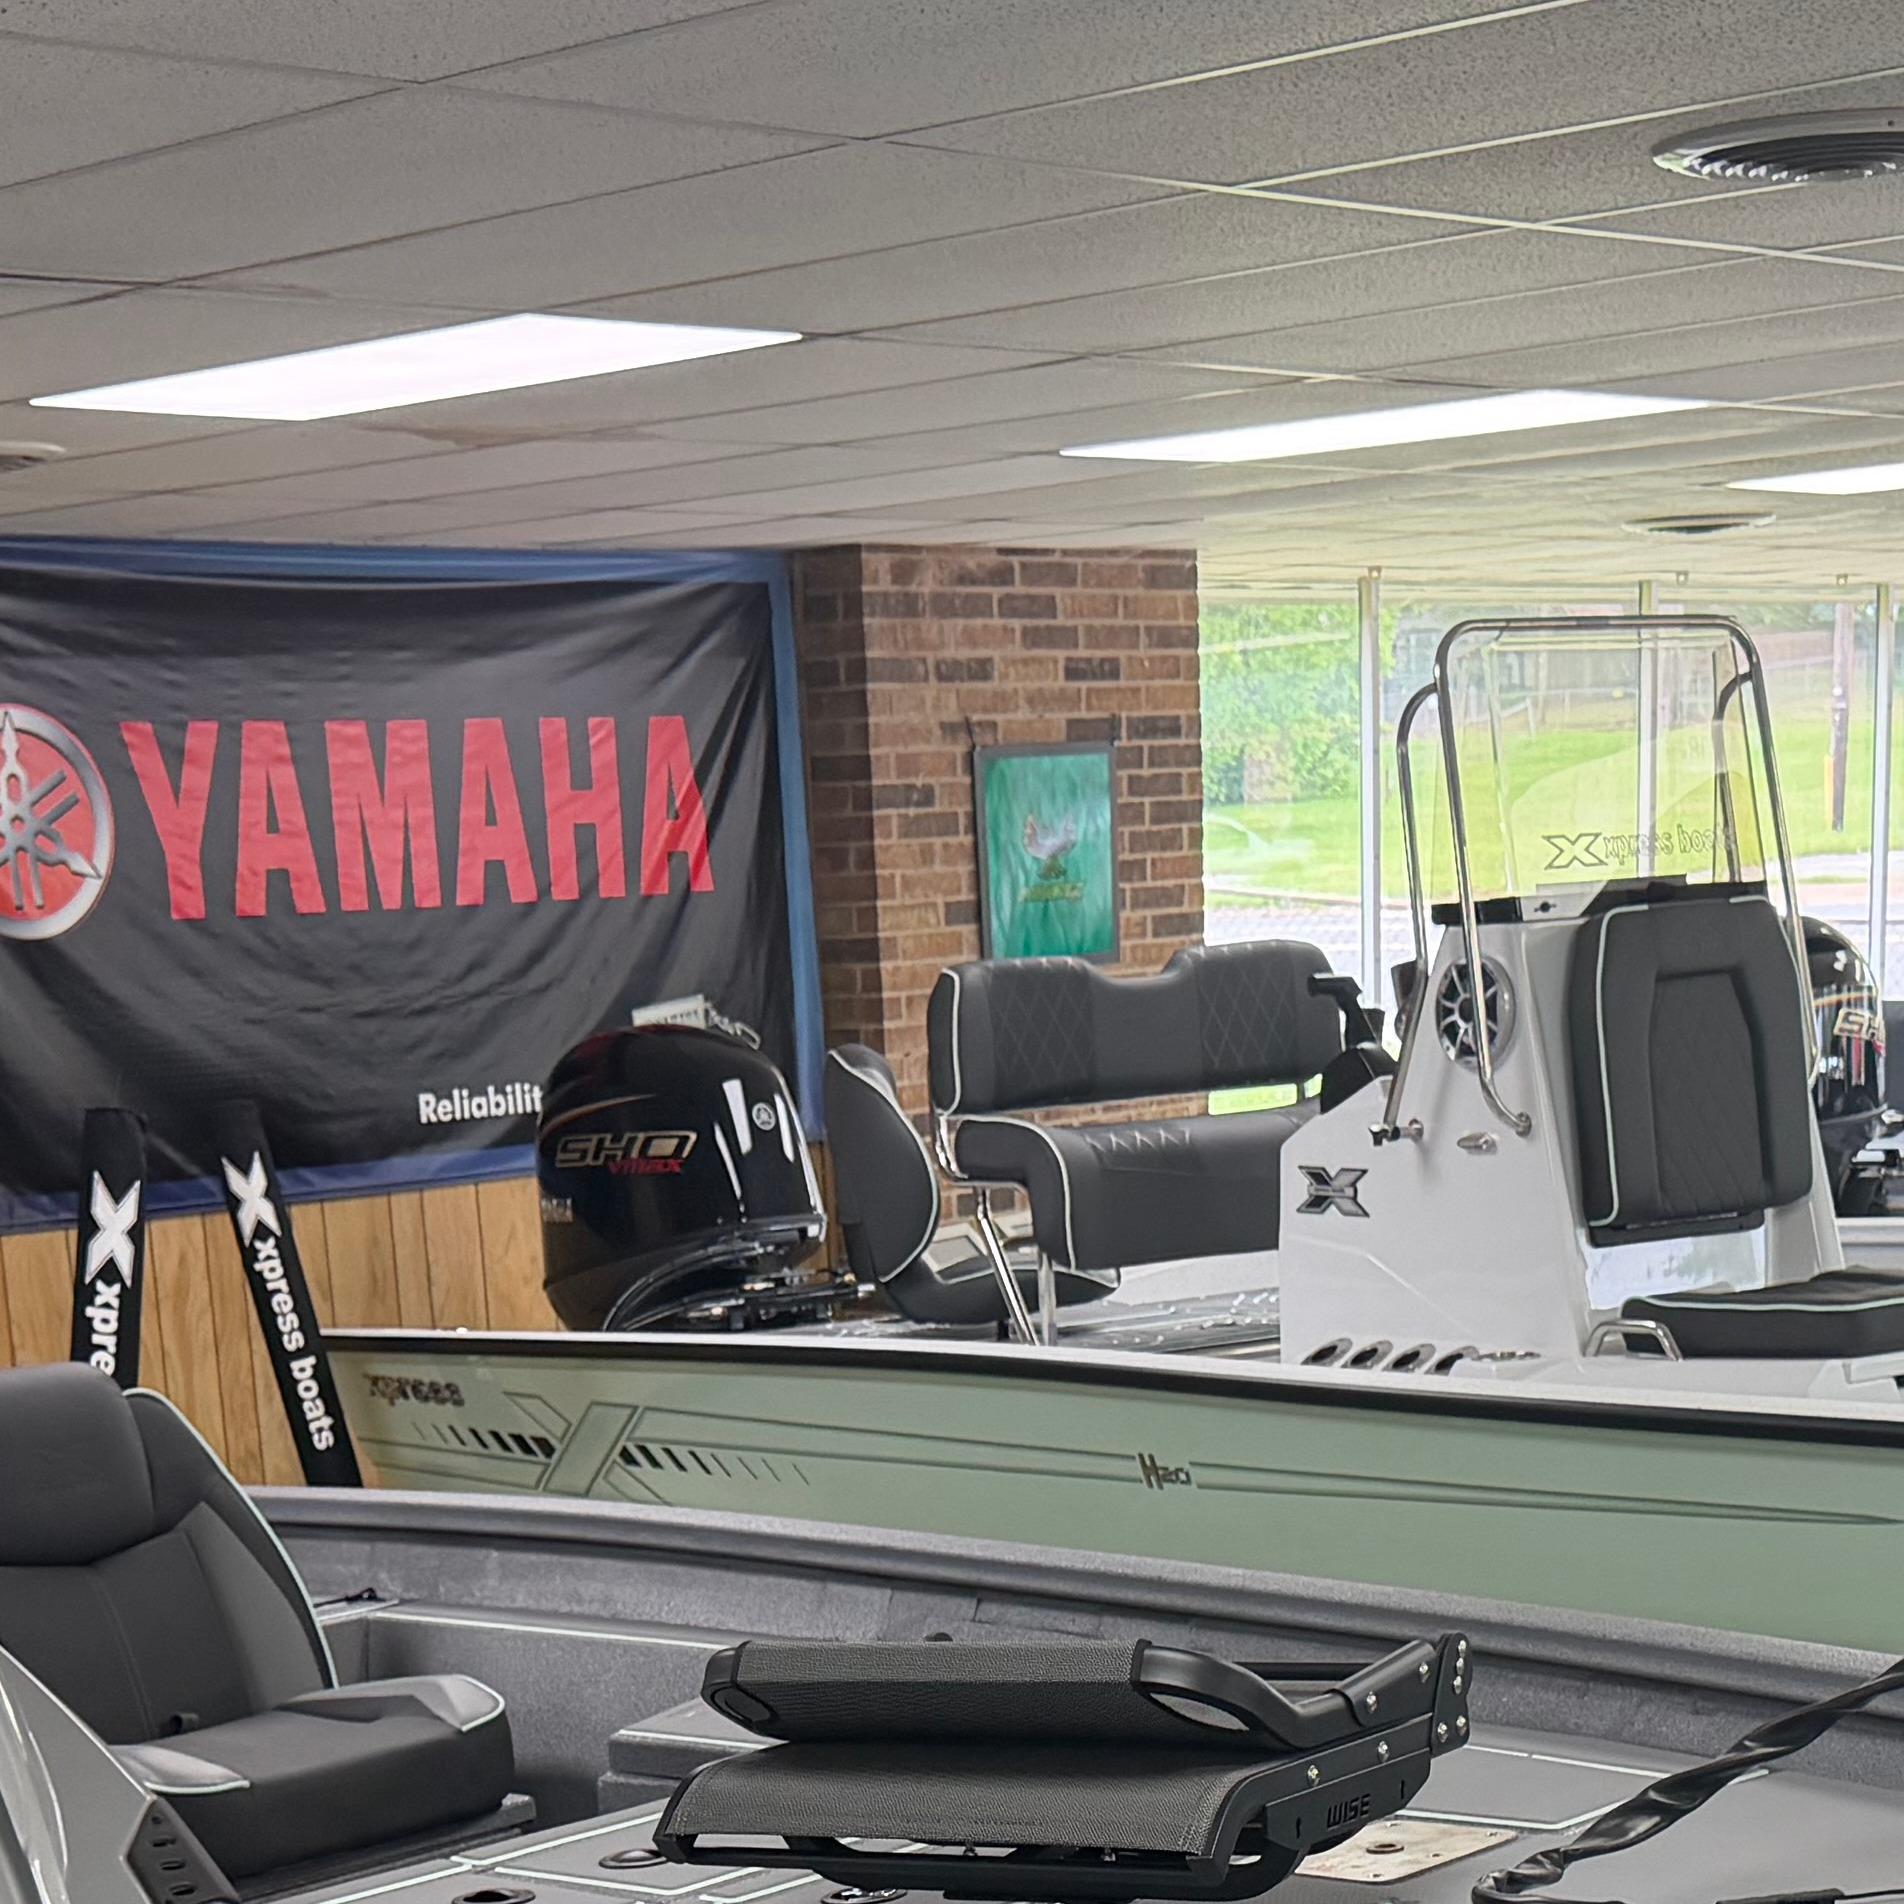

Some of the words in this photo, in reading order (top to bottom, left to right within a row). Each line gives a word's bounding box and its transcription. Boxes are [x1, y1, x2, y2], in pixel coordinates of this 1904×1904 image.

[120, 715, 714, 920] YAMAHA
[418, 1083, 543, 1124] Reliabilit
[555, 1130, 697, 1169] SHO
[85, 1278, 121, 1377] xpre
[253, 1236, 305, 1352] xpress
[289, 1355, 335, 1451] boats
[1327, 1793, 1371, 1828] WISE
